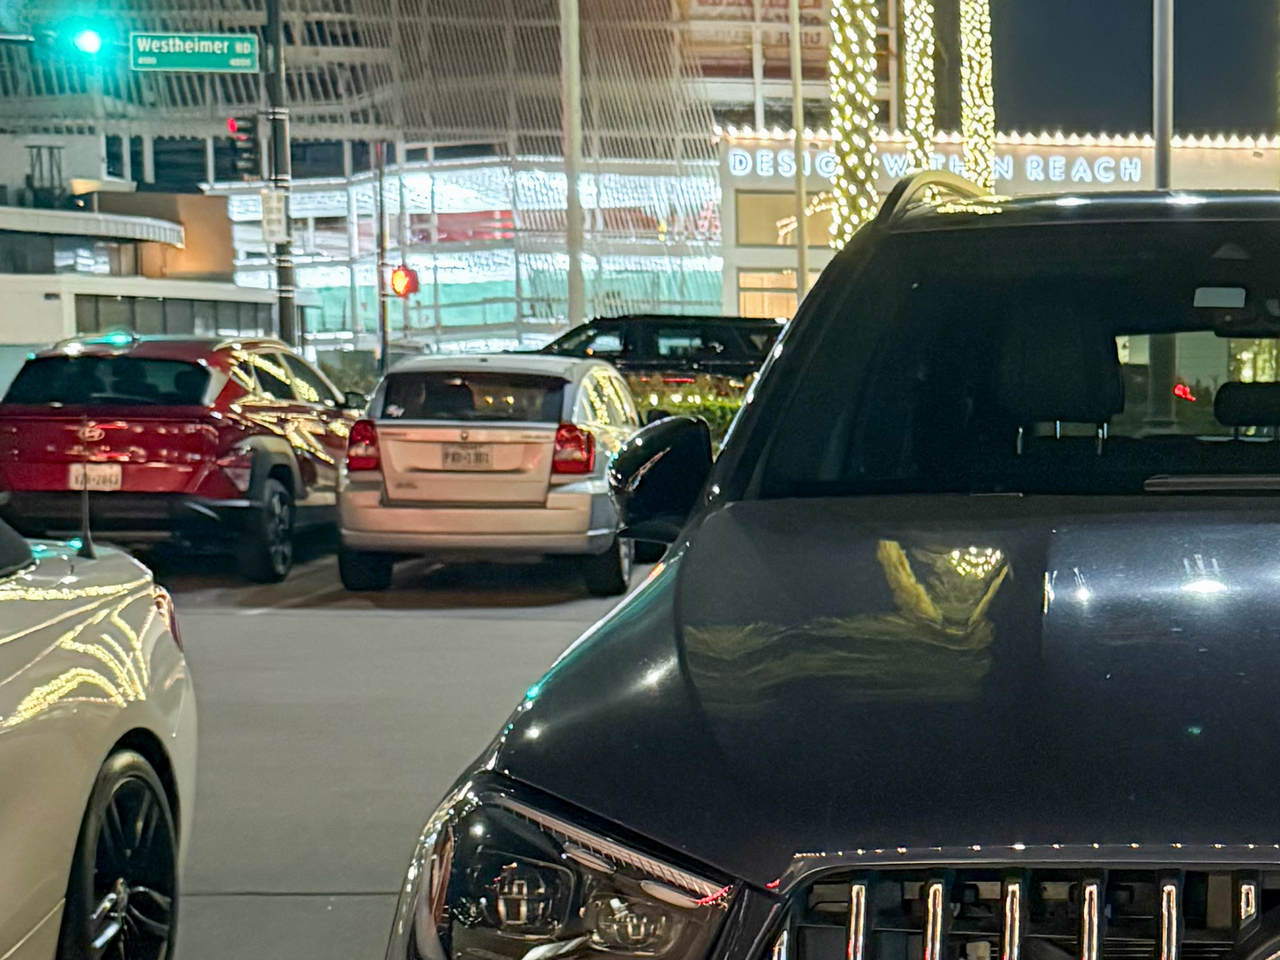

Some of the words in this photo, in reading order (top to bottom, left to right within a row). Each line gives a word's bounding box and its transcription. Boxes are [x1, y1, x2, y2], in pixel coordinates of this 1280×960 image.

[137, 36, 229, 54] Westheimer
[729, 150, 850, 178] DESIG
[1025, 154, 1142, 183] REACH
